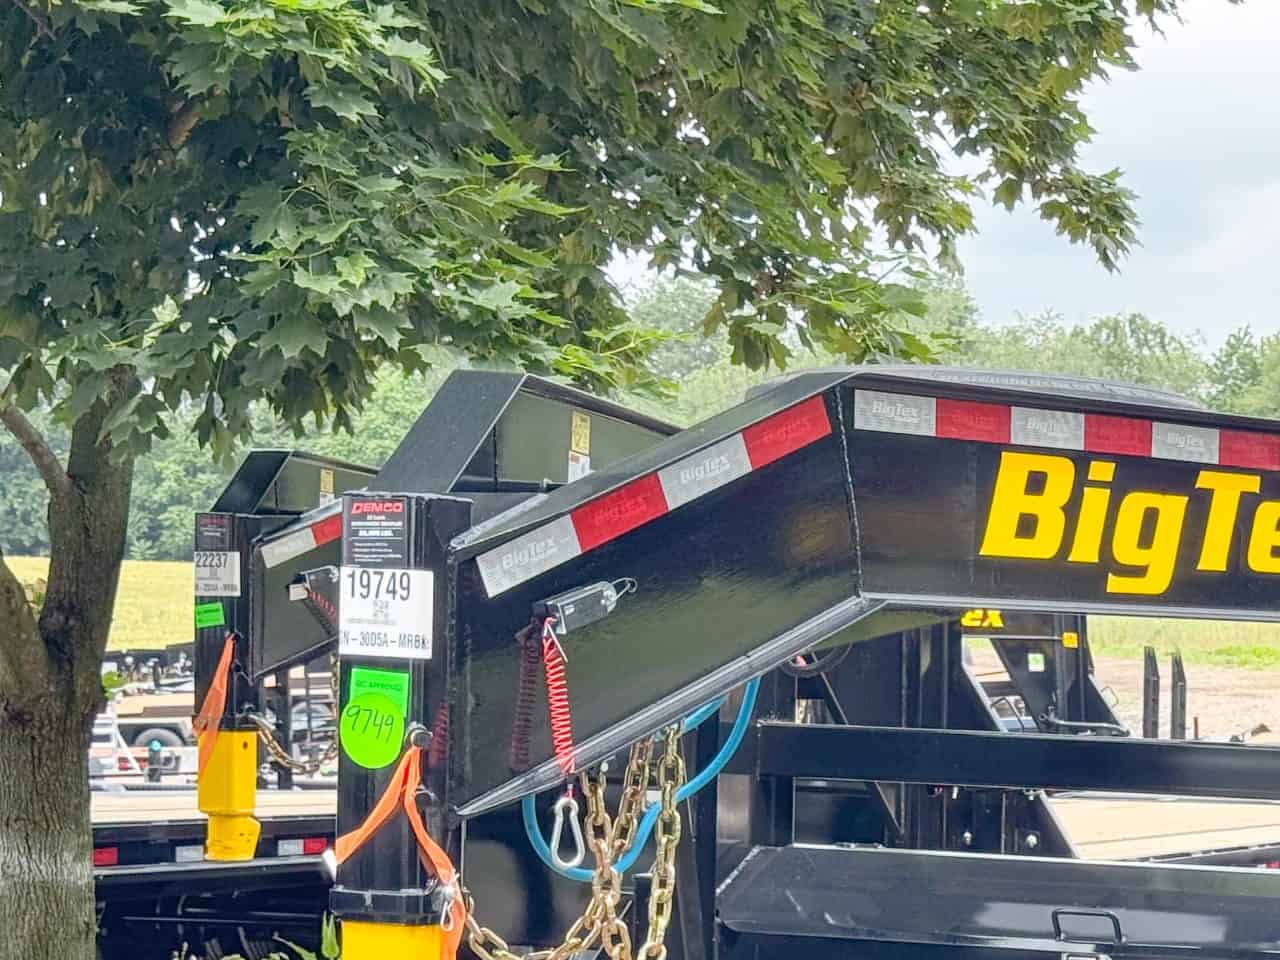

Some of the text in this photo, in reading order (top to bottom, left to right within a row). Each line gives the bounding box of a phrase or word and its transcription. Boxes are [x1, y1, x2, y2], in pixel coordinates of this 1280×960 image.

[871, 400, 920, 418] BigTex
[680, 453, 731, 485] BigTex
[351, 502, 403, 514] DEMCO
[196, 552, 228, 568] 22237
[502, 537, 559, 570] BigTex
[347, 569, 411, 601] 19749
[346, 704, 394, 744] 9749
